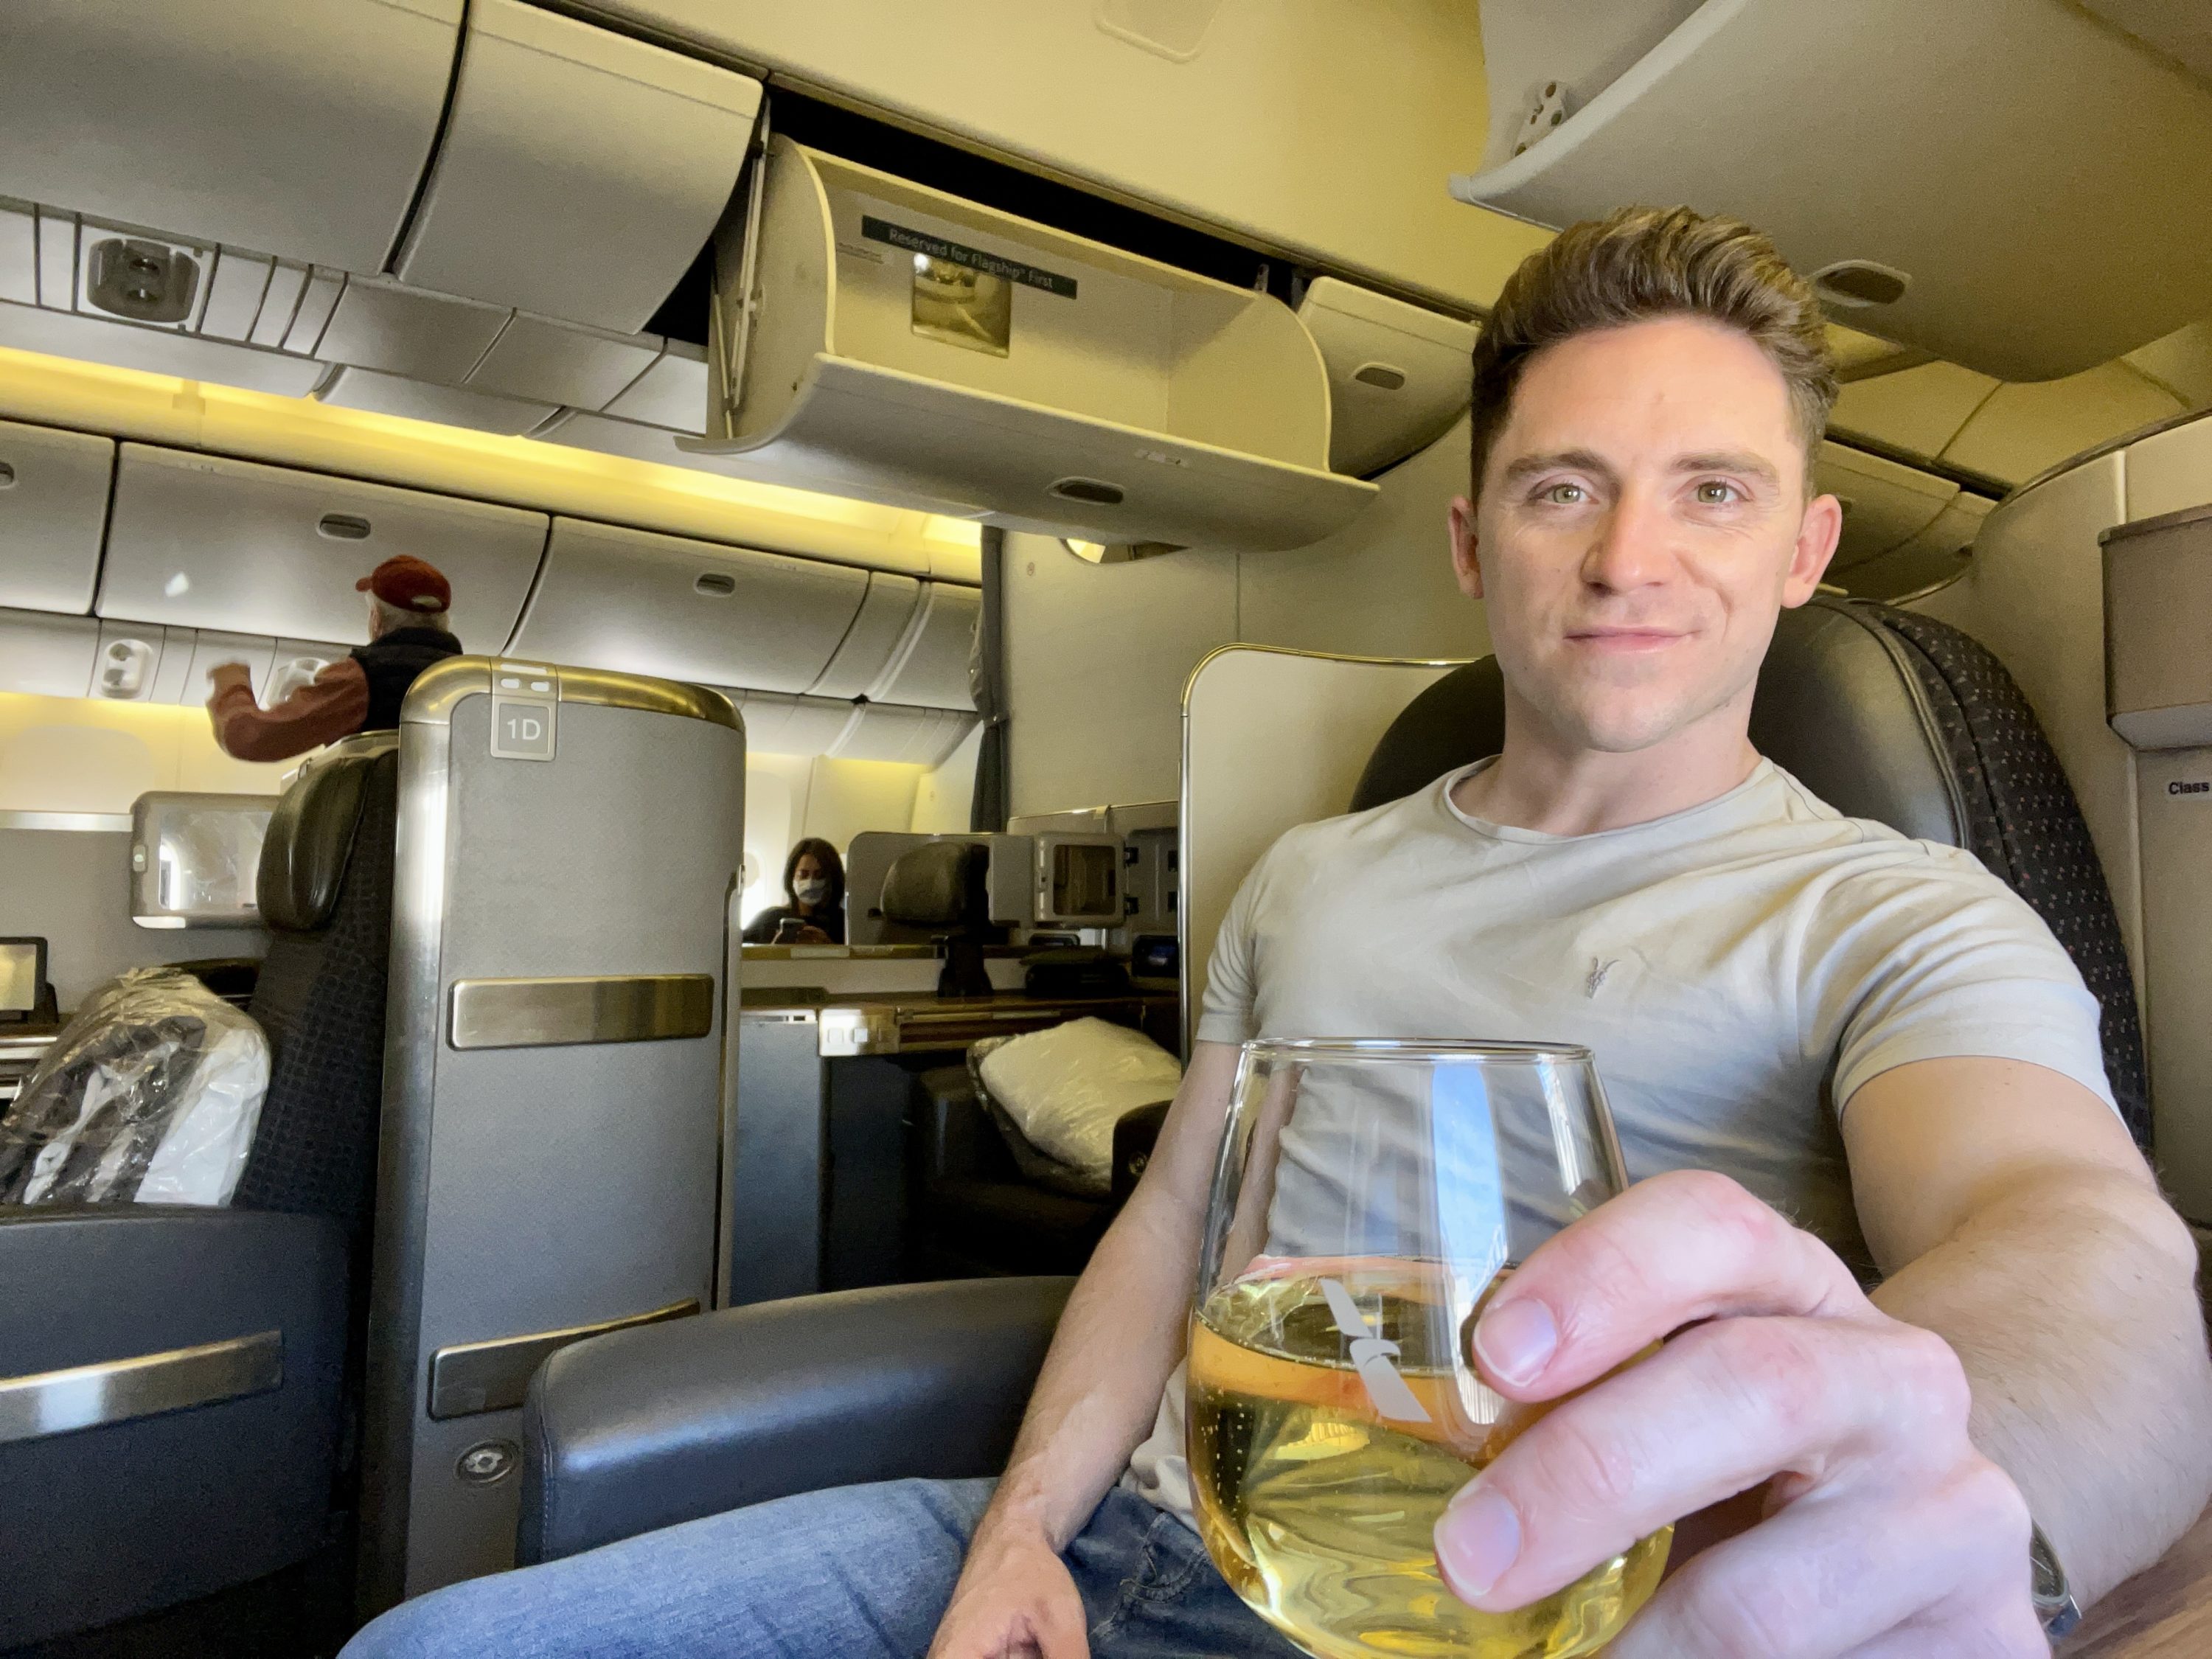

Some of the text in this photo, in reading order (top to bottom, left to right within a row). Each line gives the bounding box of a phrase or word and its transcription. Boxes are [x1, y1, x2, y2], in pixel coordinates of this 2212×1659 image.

[889, 229, 947, 257] Reserved
[950, 245, 968, 262] for
[1028, 270, 1054, 289] First
[507, 718, 540, 740] 1D
[2168, 782, 2210, 795] Class
